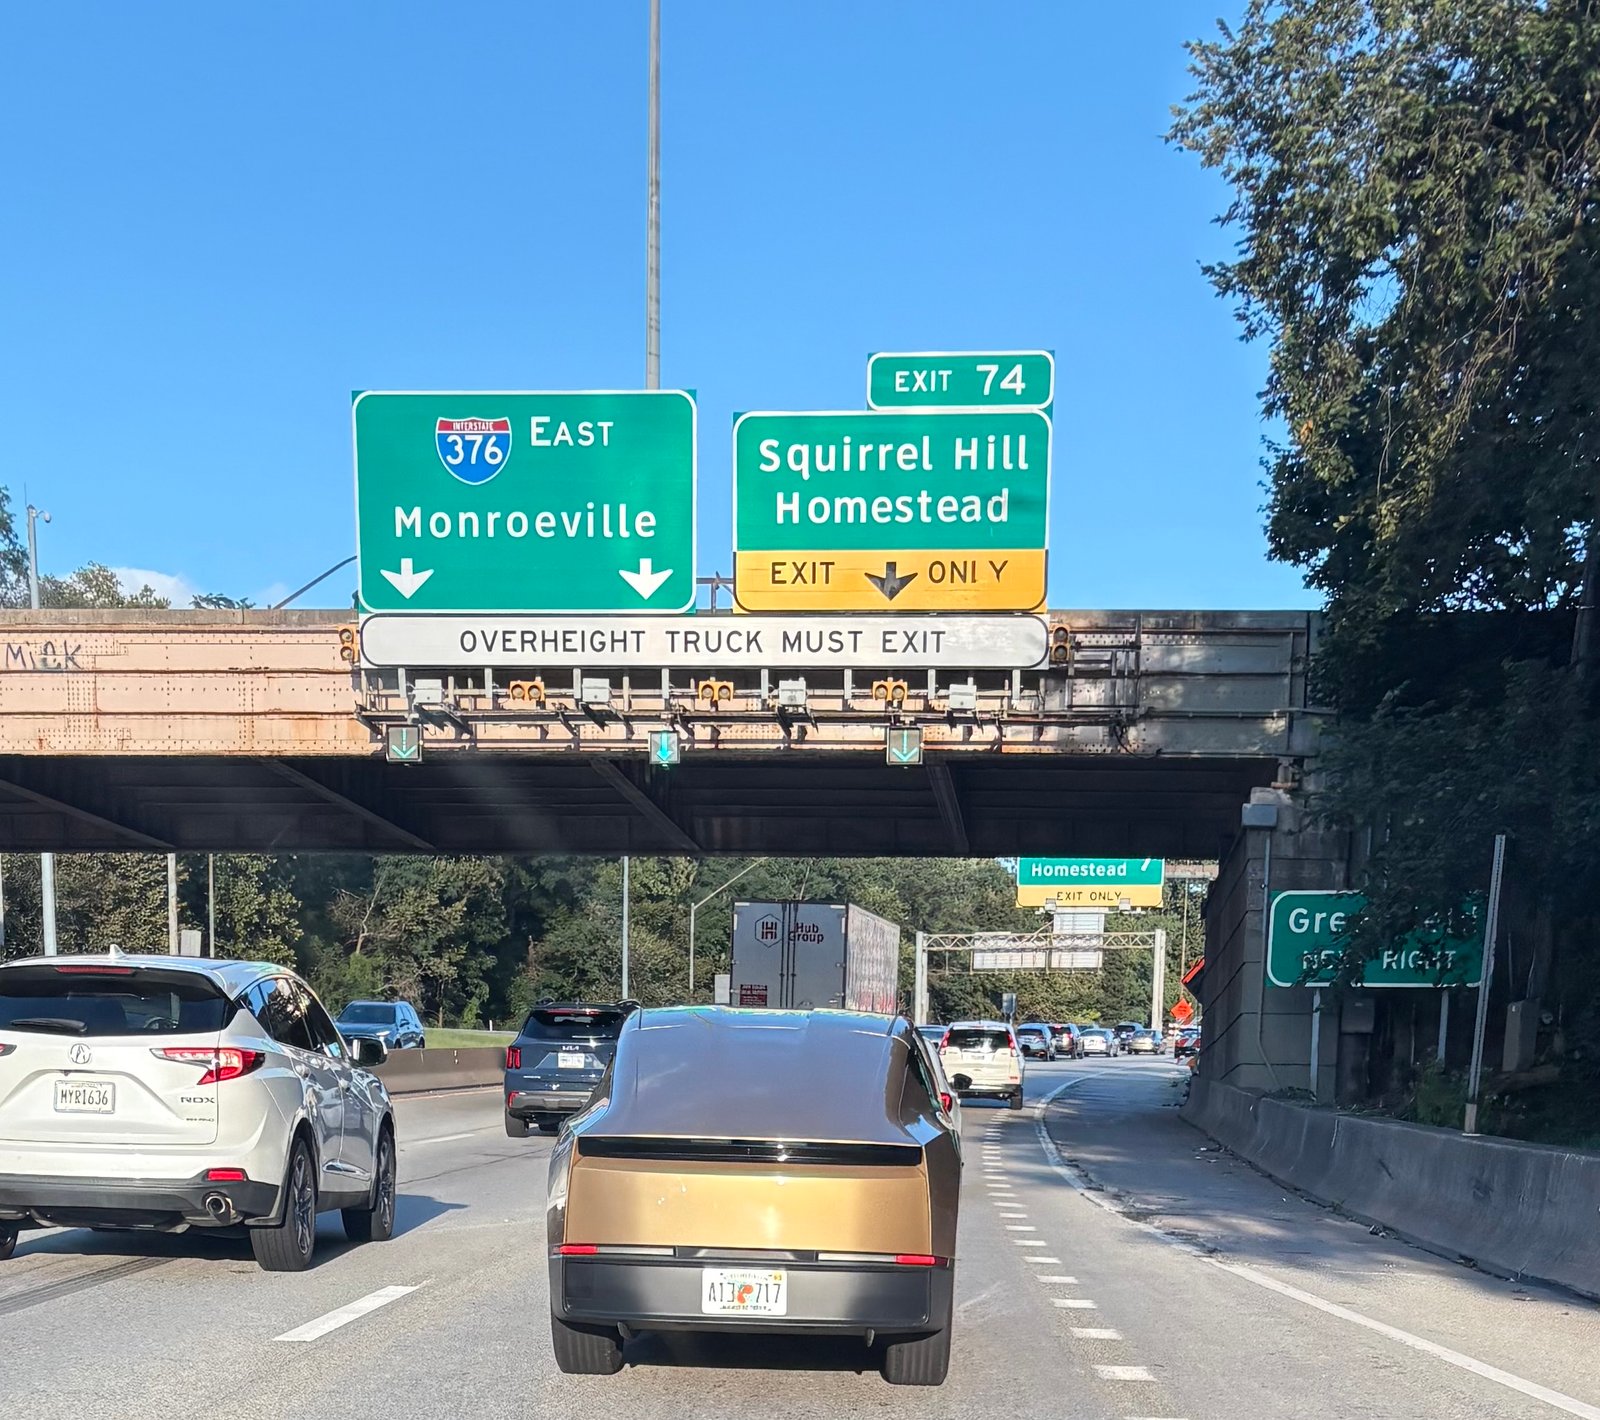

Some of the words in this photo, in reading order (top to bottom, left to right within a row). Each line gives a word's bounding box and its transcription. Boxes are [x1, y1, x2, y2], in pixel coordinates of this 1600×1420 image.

[895, 370, 952, 392] EXIT
[976, 364, 1026, 395] 74
[453, 421, 494, 431] INTERSTATE
[530, 416, 614, 446] EAST
[446, 434, 503, 465] 376
[759, 435, 933, 480] Squirrel
[955, 434, 1029, 470] Hill
[776, 488, 1009, 524] Homestead
[394, 502, 657, 538] Monroeville
[771, 561, 835, 585] EXIT
[460, 630, 646, 653] OVERHEIGHT
[665, 630, 764, 653] TRUCK
[782, 630, 863, 653] MUST
[882, 630, 946, 653] EXIT
[1031, 862, 1127, 877] Homestead
[1056, 891, 1083, 901] EXIT
[1089, 891, 1122, 901] ONLY
[788, 931, 825, 944] Group
[795, 922, 819, 933] Hub
